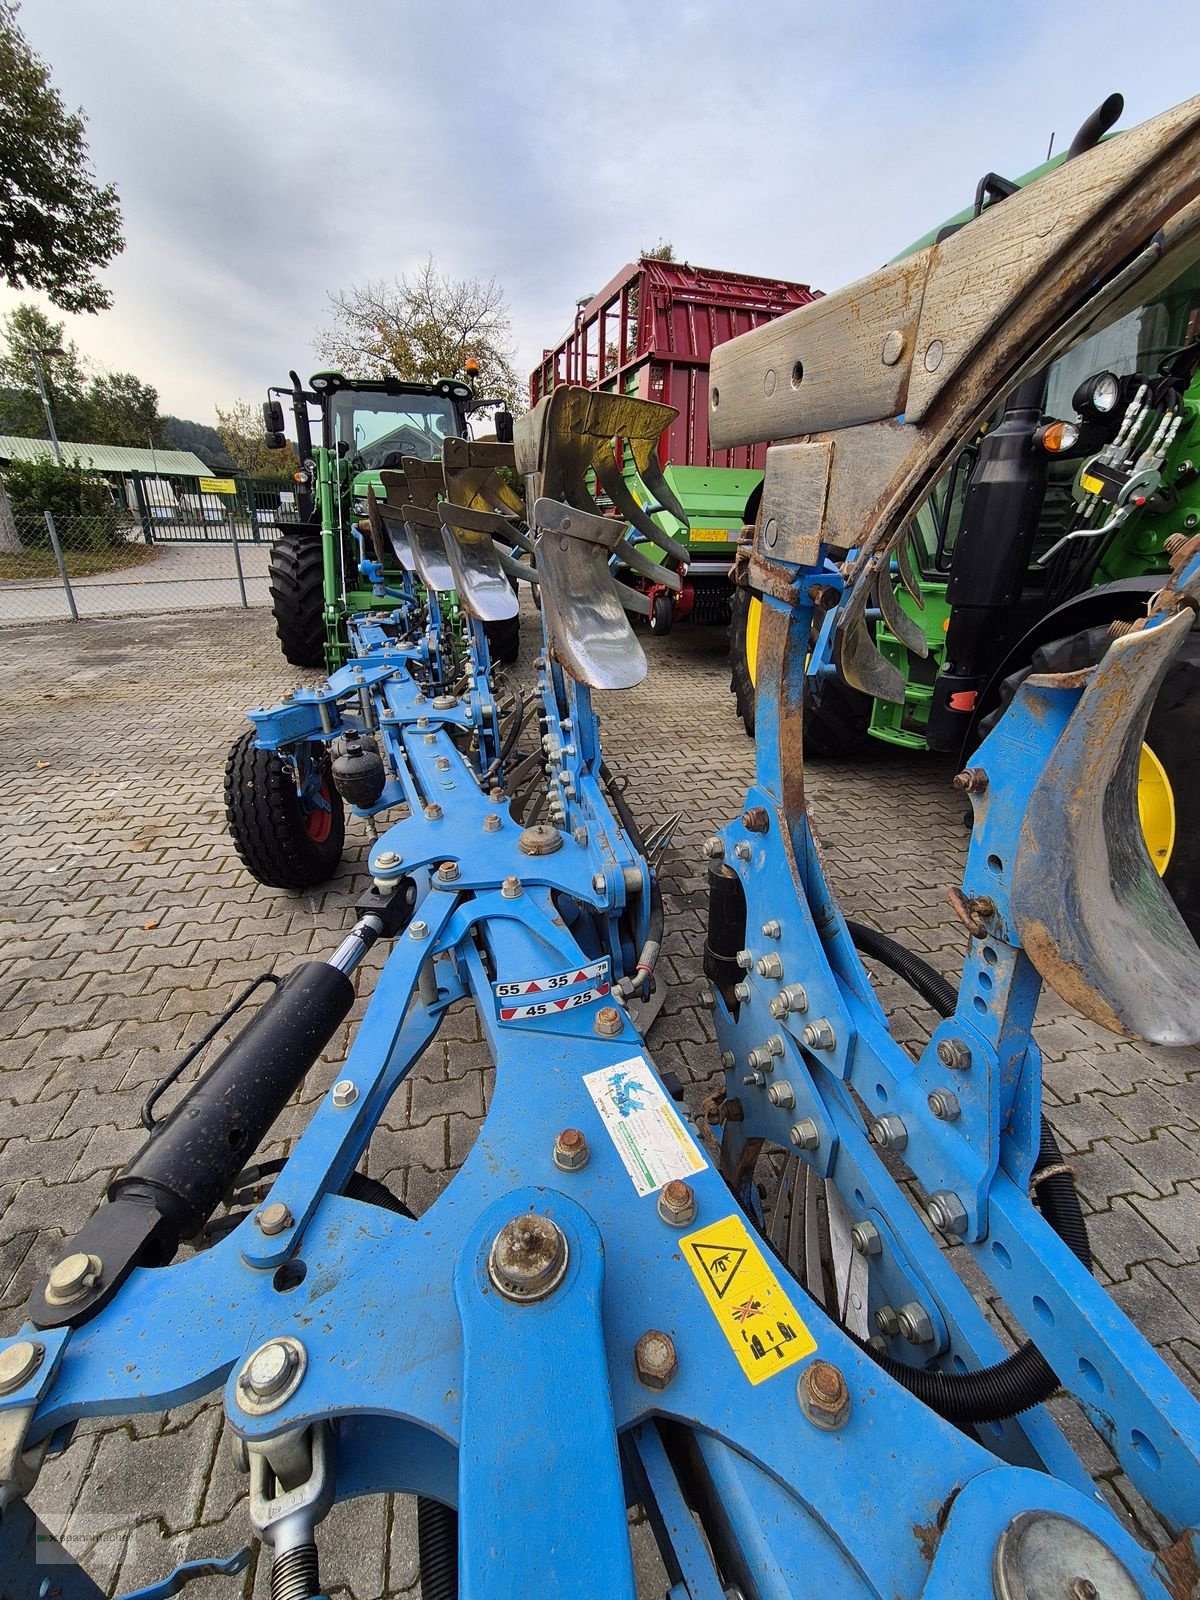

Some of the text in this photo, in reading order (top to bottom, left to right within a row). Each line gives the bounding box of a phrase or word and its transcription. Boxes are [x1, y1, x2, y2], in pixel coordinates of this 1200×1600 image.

[499, 985, 520, 996] 55
[548, 976, 569, 988] 35
[526, 992, 592, 1016] 45 25
